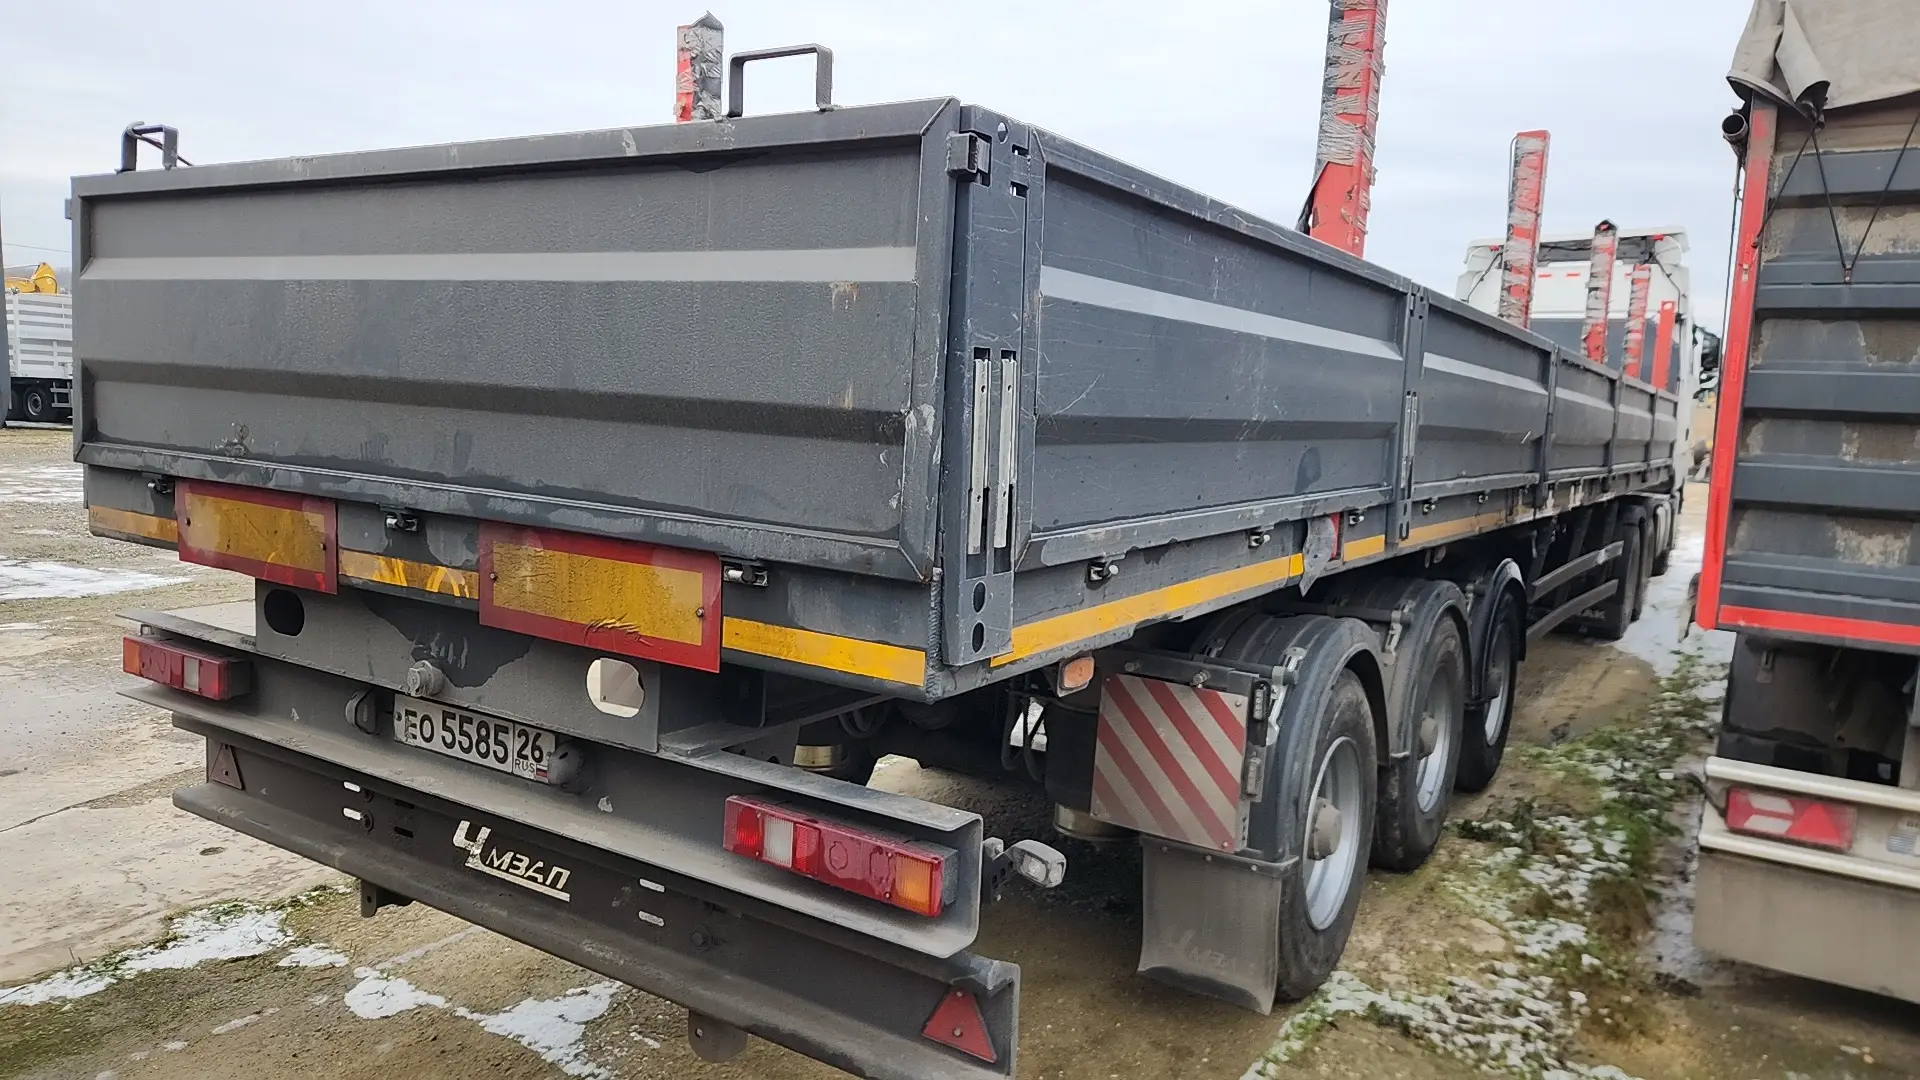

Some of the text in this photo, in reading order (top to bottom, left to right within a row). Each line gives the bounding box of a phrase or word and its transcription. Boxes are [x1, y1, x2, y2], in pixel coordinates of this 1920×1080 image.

[441, 710, 509, 764] 5585
[516, 728, 544, 763] 26
[514, 758, 535, 774] RUS
[452, 819, 571, 898] ЧМЗАП
